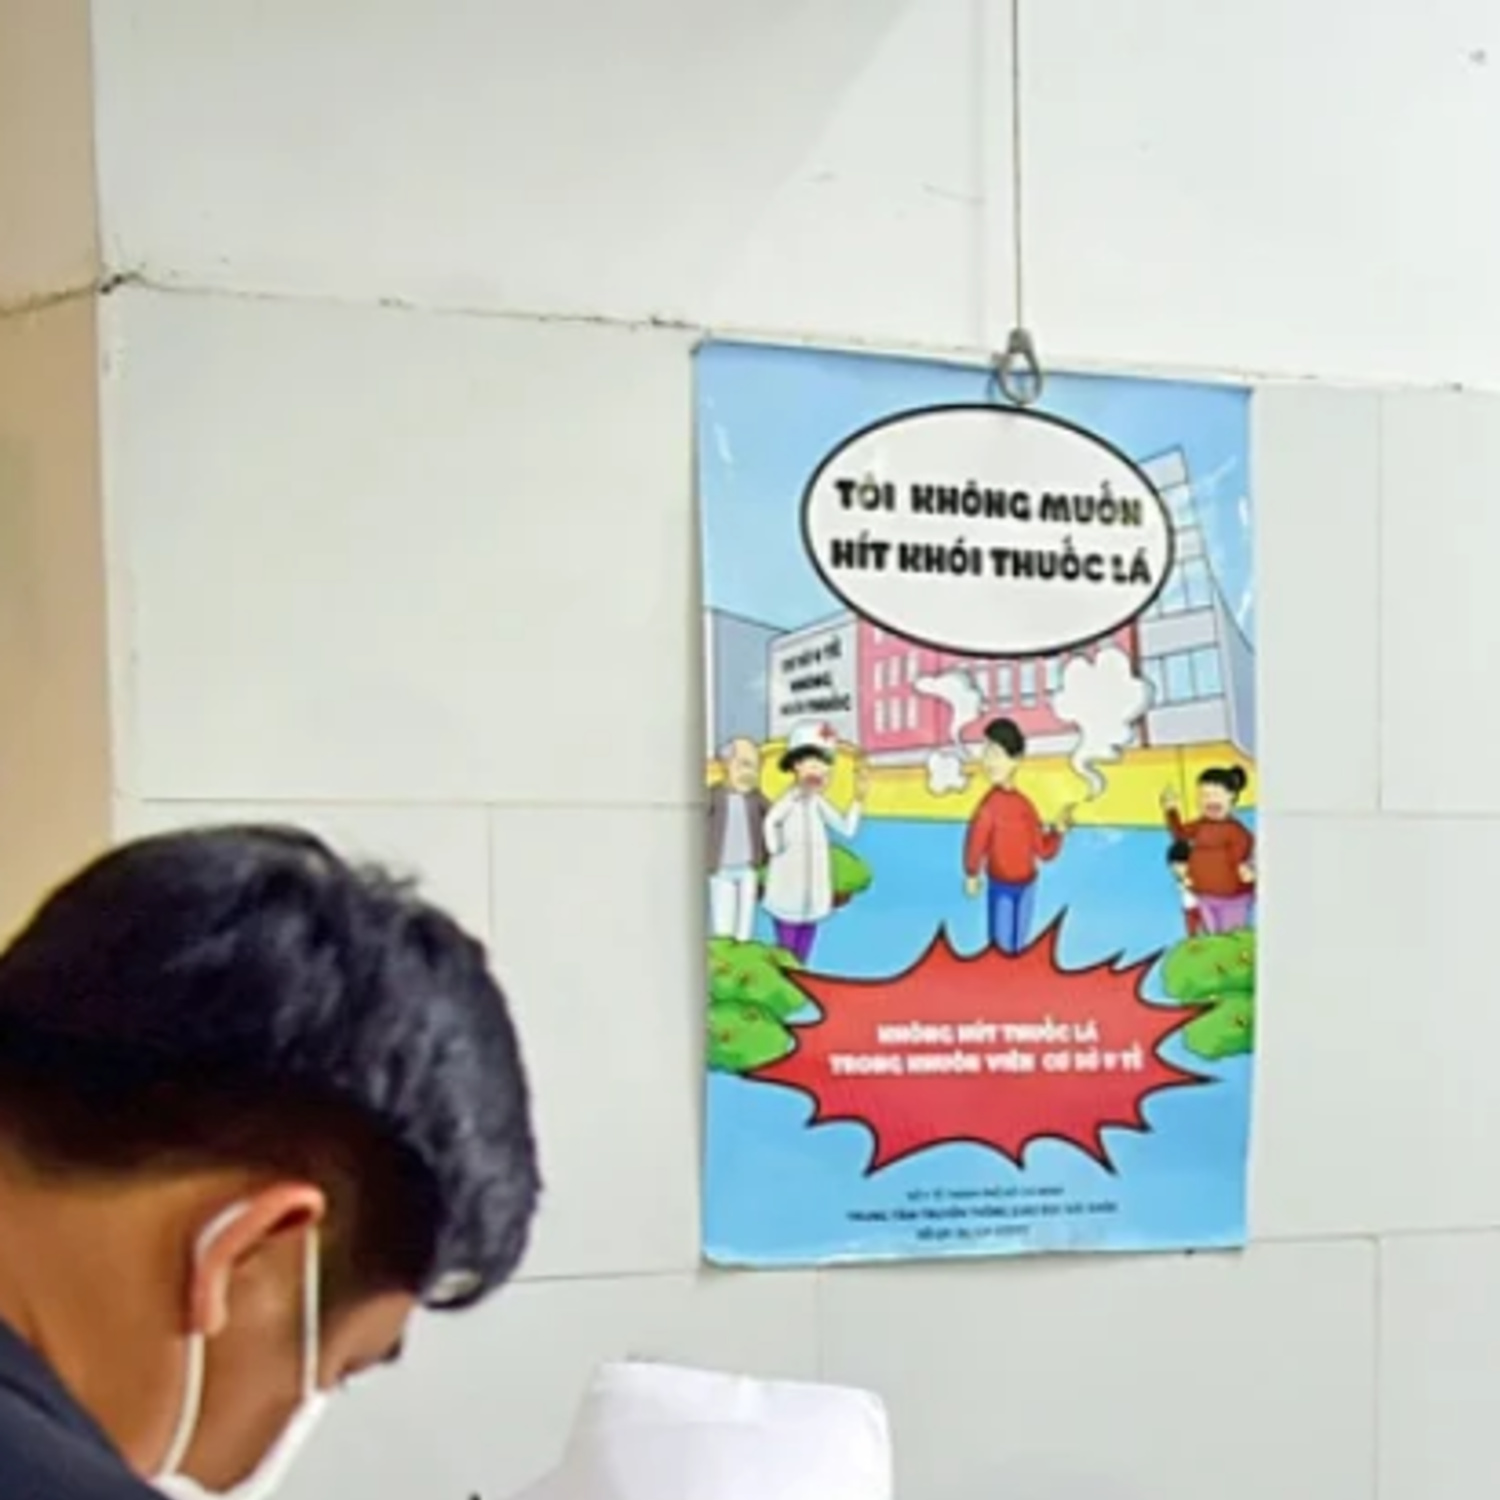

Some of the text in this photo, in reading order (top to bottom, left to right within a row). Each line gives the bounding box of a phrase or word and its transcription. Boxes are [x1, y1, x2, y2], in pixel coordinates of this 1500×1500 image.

[835, 473, 1140, 526] TÔI KHÔNG MUỐN
[831, 531, 1151, 584] HÍT KHÓI THUỐC LÁ
